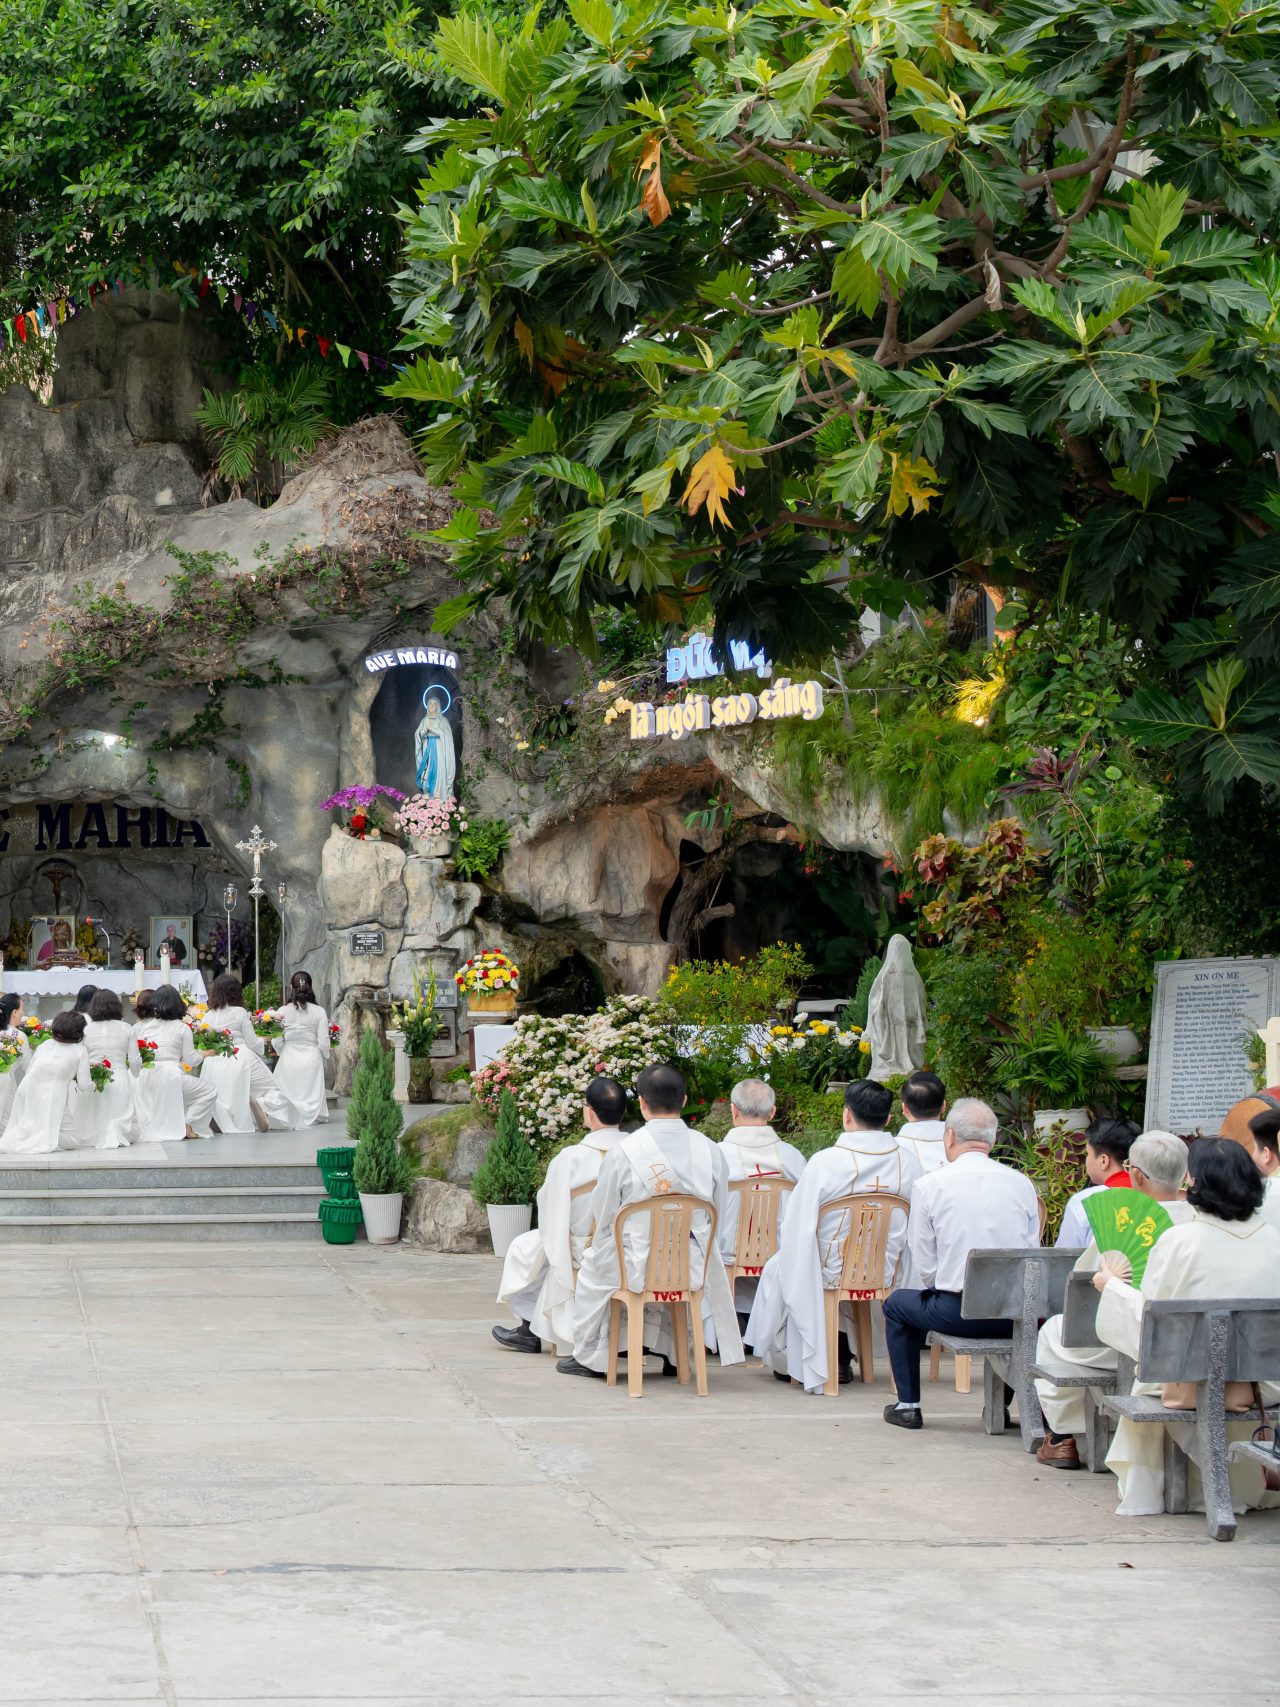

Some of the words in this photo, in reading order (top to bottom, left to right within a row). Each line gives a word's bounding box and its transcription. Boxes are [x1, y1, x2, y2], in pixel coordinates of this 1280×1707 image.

[365, 653, 398, 673] AVE
[397, 650, 457, 670] MARIA
[630, 702, 653, 740] là
[655, 694, 707, 741] ngôi
[711, 692, 755, 727] sao
[758, 677, 820, 721] sáng
[34, 803, 212, 851] MARIA
[1194, 973, 1210, 982] XIN
